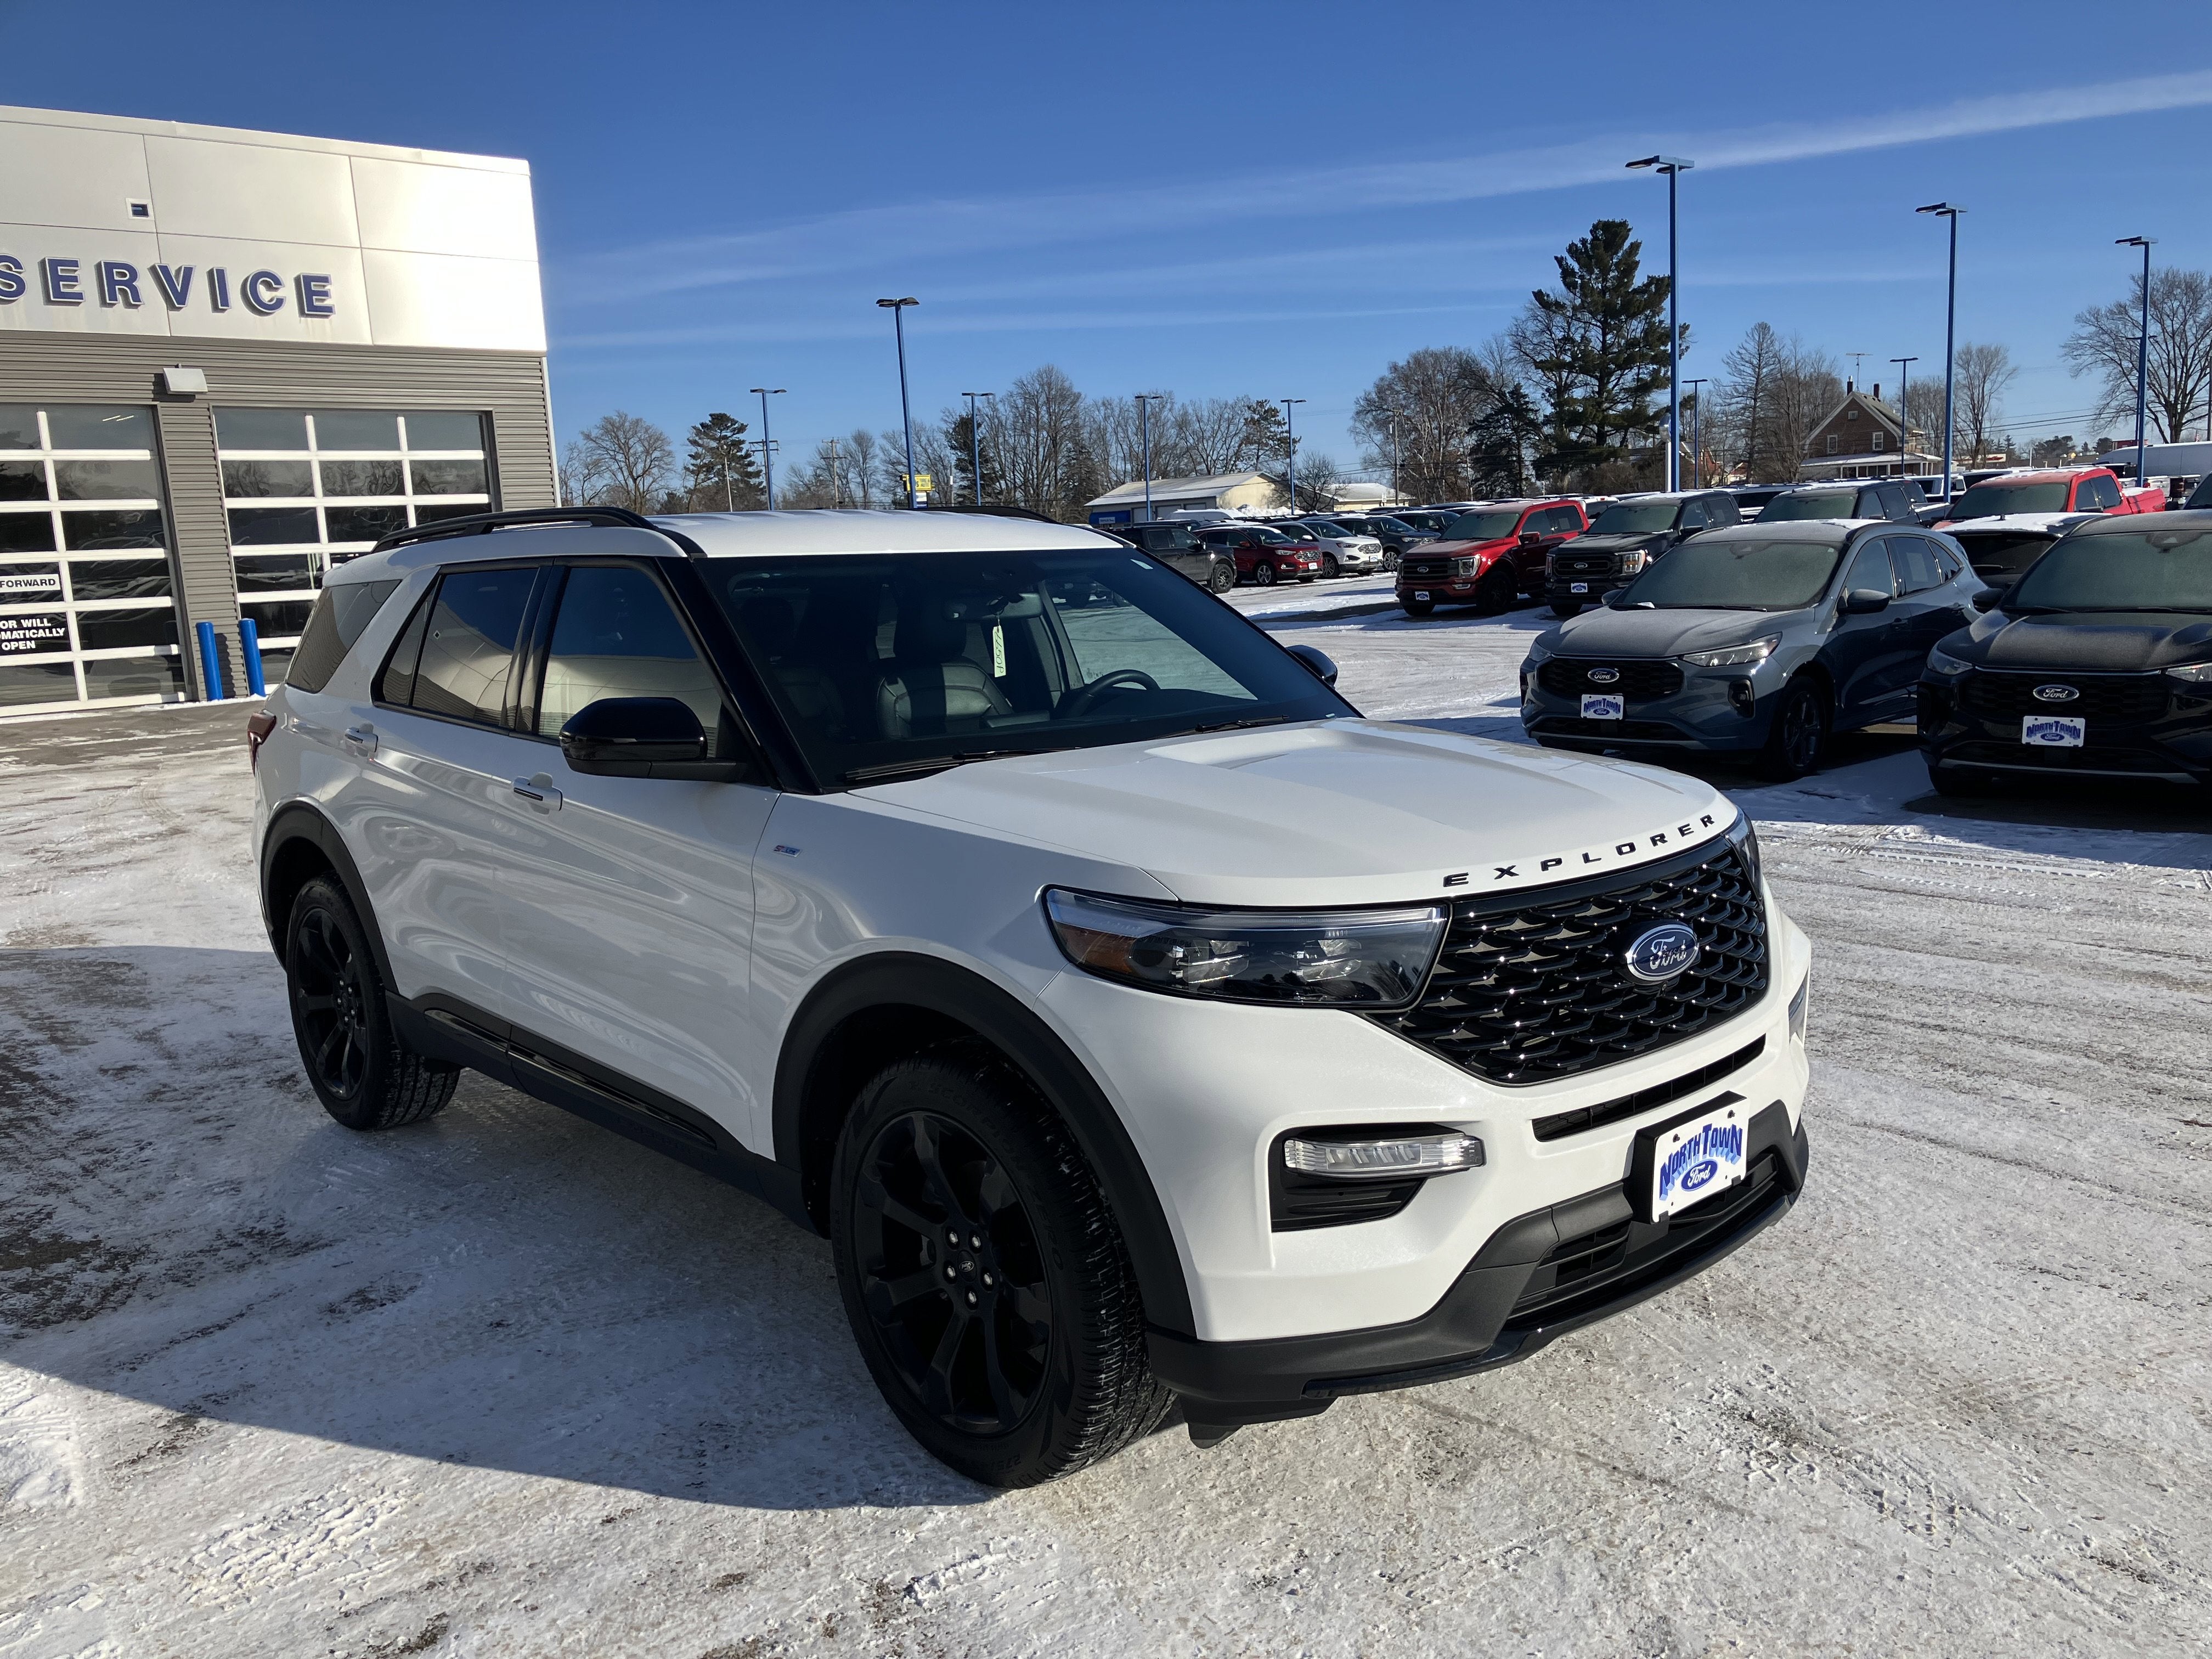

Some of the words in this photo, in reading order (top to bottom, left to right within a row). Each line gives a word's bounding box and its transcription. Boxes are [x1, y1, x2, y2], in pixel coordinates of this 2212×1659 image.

[0, 253, 336, 319] SERVICE
[0, 578, 56, 588] FORWARD
[20, 618, 52, 628] WILL
[0, 628, 65, 640] MATICALLY
[1, 640, 36, 651] OPEN
[2042, 687, 2068, 698] Ford
[1443, 814, 1715, 888] EXPLORER
[1650, 935, 1687, 969] Ford
[1687, 1164, 1711, 1187] Ford
